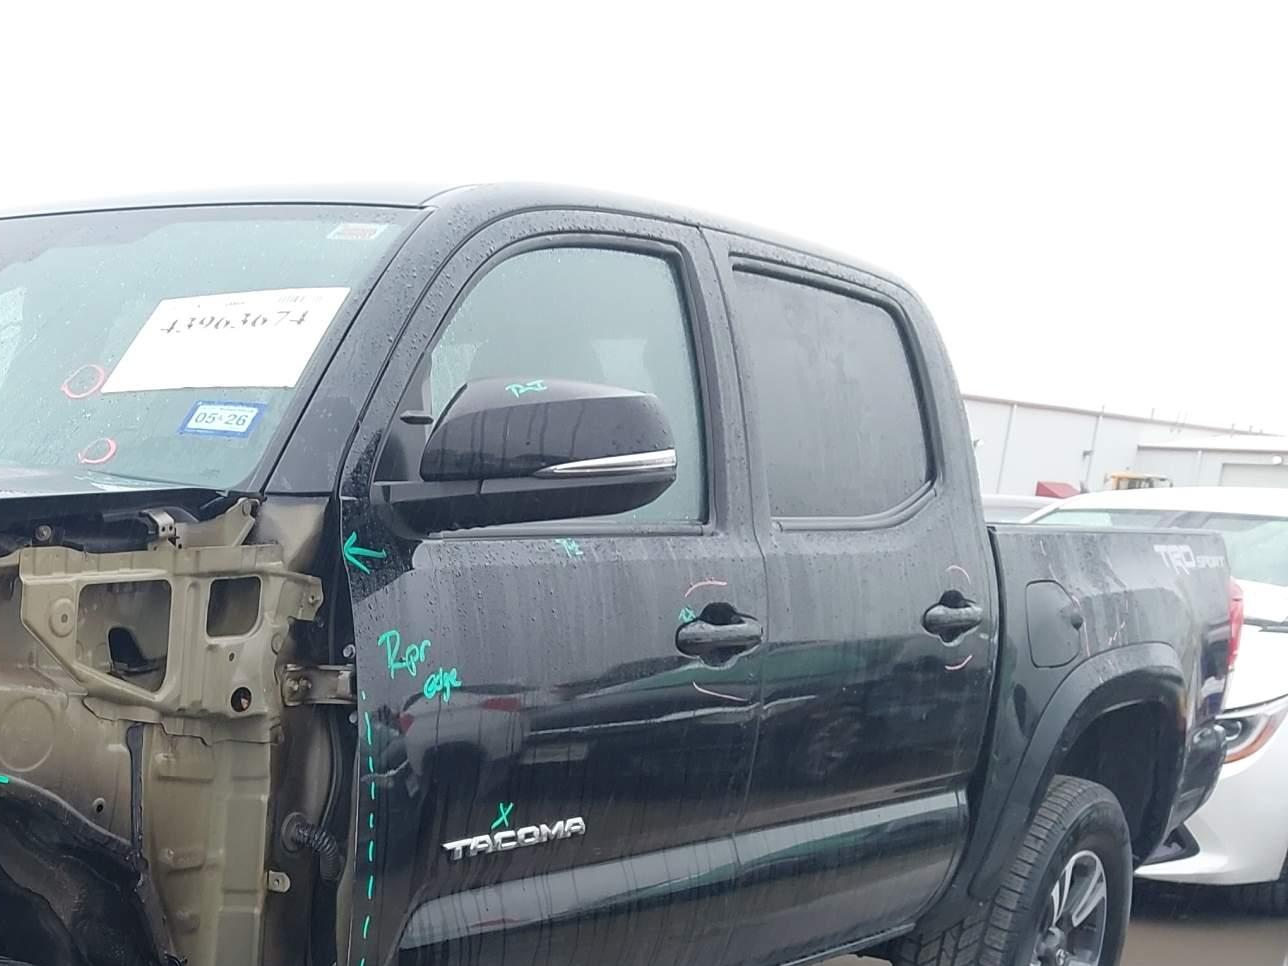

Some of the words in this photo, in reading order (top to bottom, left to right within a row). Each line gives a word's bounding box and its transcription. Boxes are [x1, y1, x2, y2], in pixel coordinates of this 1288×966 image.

[194, 412, 219, 424] 05
[224, 413, 249, 426] 26
[1153, 545, 1196, 575] TRD
[442, 816, 586, 861] TACOMA
